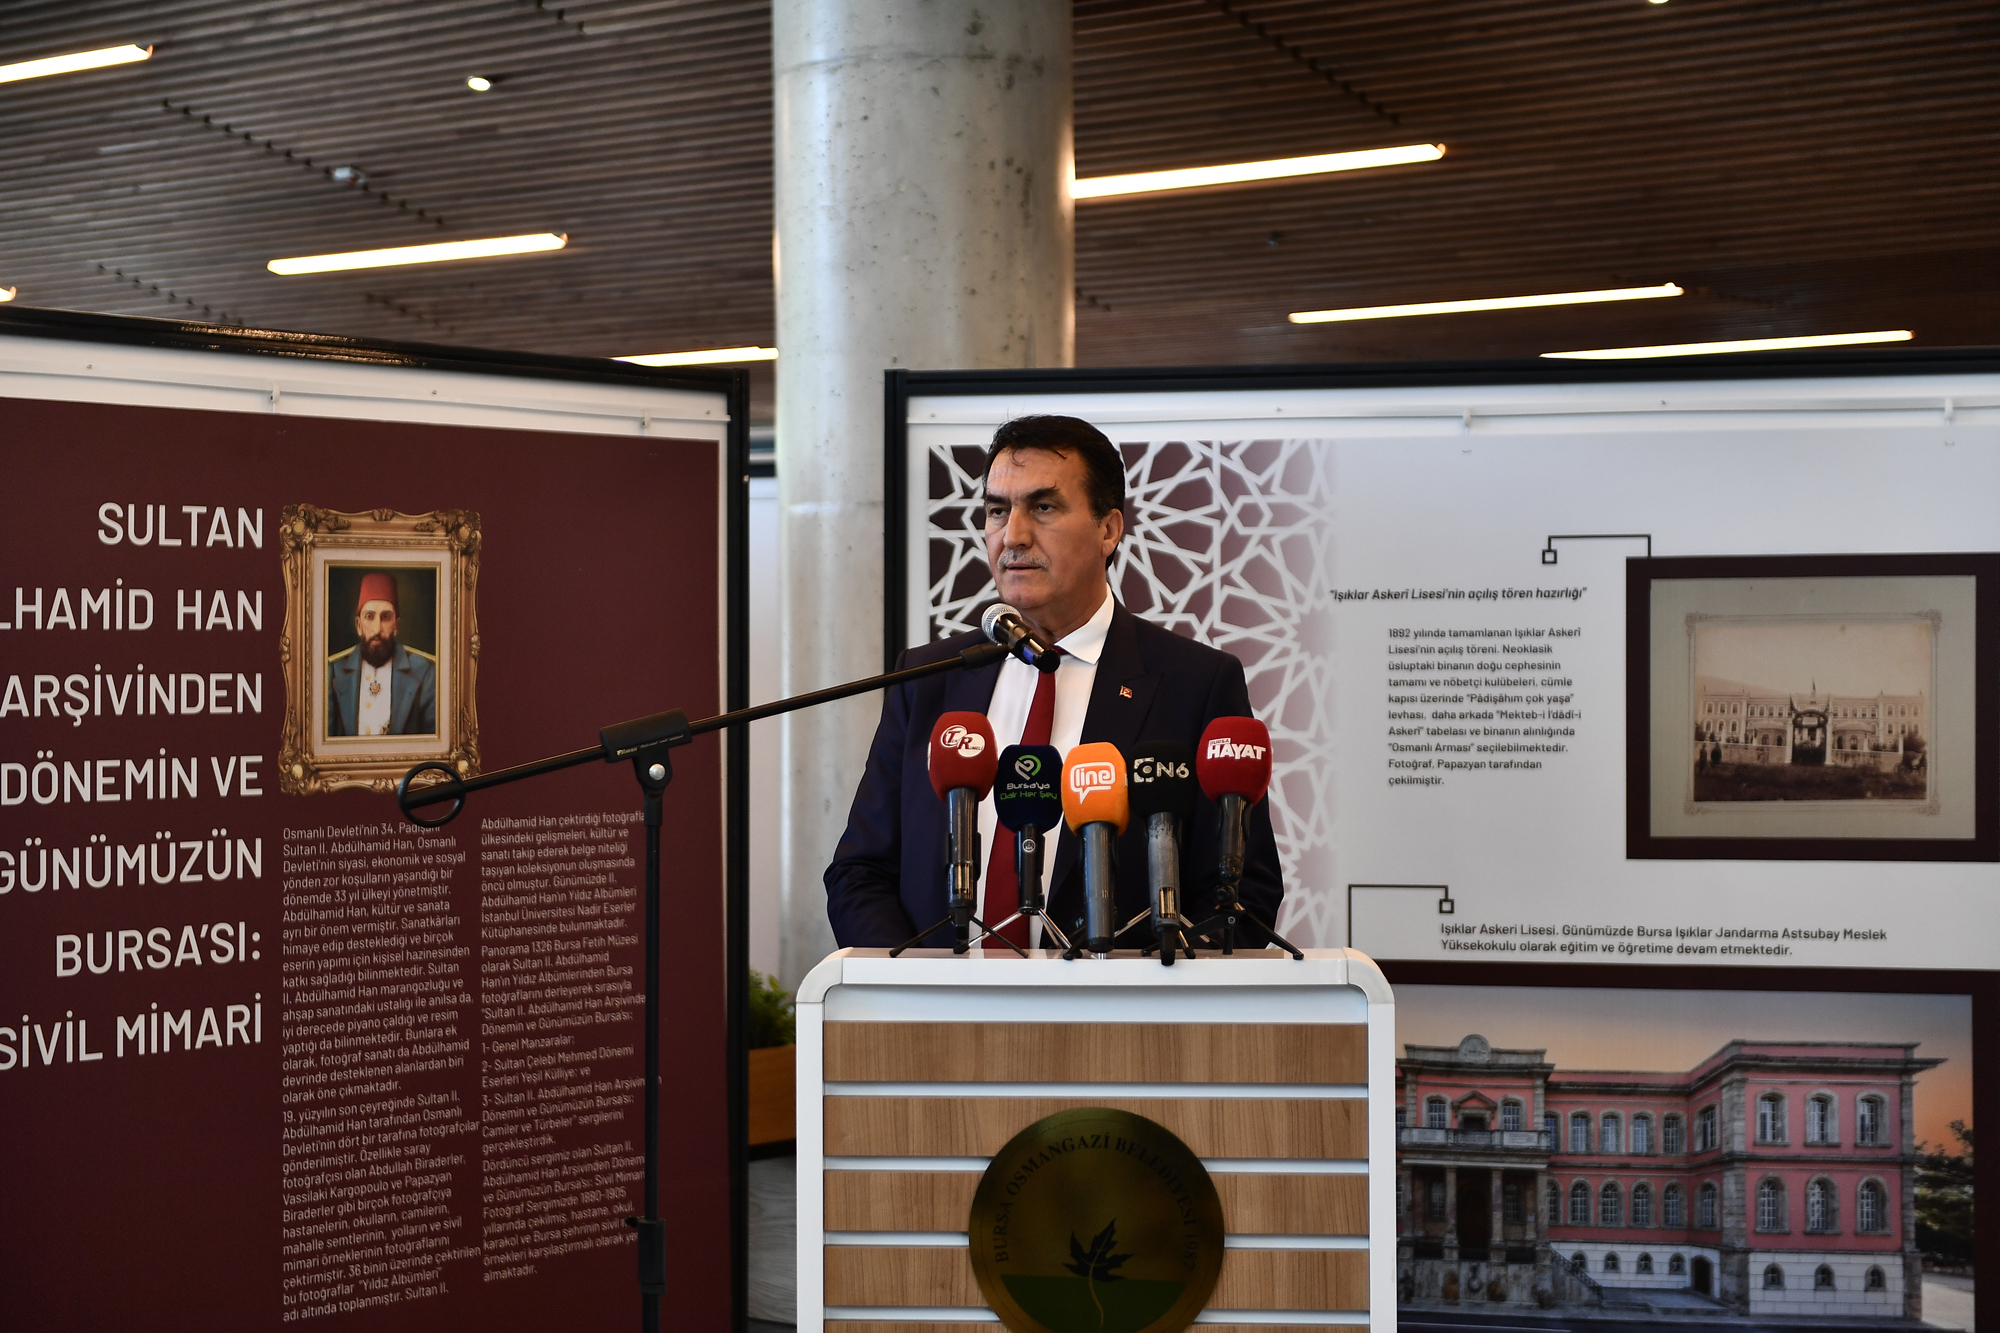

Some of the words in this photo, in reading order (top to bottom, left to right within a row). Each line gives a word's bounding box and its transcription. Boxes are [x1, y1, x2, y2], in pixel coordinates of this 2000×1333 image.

[98, 503, 262, 549] SULTAN
[1467, 588, 1498, 601] açılış
[1501, 587, 1533, 598] tören
[0, 577, 154, 631] HAMİD
[178, 589, 262, 631] HAN
[1388, 628, 1411, 638] 1892
[1412, 628, 1446, 639] yılında
[1447, 628, 1512, 638] tamamlanan
[1514, 627, 1545, 639] Işıklar
[1436, 644, 1464, 656] açılış
[1465, 645, 1499, 654] töreni.
[1501, 644, 1553, 654] Neoklasik
[1387, 661, 1435, 672] üsluptaki
[1436, 661, 1474, 670] binanın
[1476, 661, 1502, 672] doğu
[1504, 661, 1561, 671] cephesinin
[1387, 678, 1427, 687] tamamı
[1428, 679, 1441, 687] ve
[1442, 677, 1482, 688] nöbetçi
[1483, 677, 1538, 686] kulübeleri,
[1540, 677, 1572, 686] cümle
[0, 664, 262, 727] ARŞİVİNDEN
[1387, 694, 1418, 705] kapısı
[1419, 693, 1464, 703] üzerinde
[1524, 693, 1544, 705] çok
[1387, 710, 1426, 719] levhası,
[1430, 710, 1456, 719] daha
[1458, 710, 1494, 720] arkada
[1425, 726, 1467, 736] tabelası
[1468, 728, 1481, 736] ve
[1482, 726, 1520, 736] binanın
[1522, 726, 1575, 738] alınlığında
[1207, 743, 1266, 760] HAYAT
[1476, 742, 1568, 753] seçilebilmektedir.
[1387, 758, 1434, 770] Fotoğraf,
[1436, 758, 1486, 770] Papazyan
[1487, 759, 1542, 769] tarafından
[1, 748, 197, 806] DÖNEMİN
[211, 756, 262, 797] VE
[1007, 782, 1050, 790] Bursa'ya
[1075, 768, 1111, 787] line
[1387, 775, 1444, 786] çekilmiştir.
[283, 827, 324, 839] Osmanlı
[327, 824, 378, 837] Devleti'nin
[380, 822, 396, 834] 34.
[481, 832, 533, 844] ülkesindeki
[535, 829, 587, 844] gelişmeleri,
[590, 827, 616, 838] kültür
[618, 828, 628, 837] ve
[283, 844, 316, 856] Sultan
[319, 842, 327, 854] II.
[330, 839, 390, 852] Abdülhamid
[392, 838, 414, 849] Han,
[417, 836, 456, 848] Osmanlı
[481, 850, 510, 860] sanatı
[512, 847, 535, 860] takip
[537, 845, 569, 857] ederek
[570, 844, 596, 856] belge
[597, 842, 627, 854] niteliği
[0, 828, 262, 894] GÜNÜMÜZÜN
[283, 859, 335, 872] Devleti'nin
[338, 857, 368, 871] siyasi,
[371, 854, 420, 866] ekonomik
[421, 854, 433, 864] ve
[435, 851, 465, 864] sosyal
[481, 866, 515, 877] taşıyan
[517, 862, 576, 876] koleksiyonun
[578, 857, 635, 870] oluşmasında
[282, 876, 320, 891] yönden
[322, 876, 339, 886] zor
[341, 872, 390, 886] koşulların
[392, 869, 438, 884] yaşandığı
[440, 867, 453, 878] bir
[481, 879, 505, 891] öncü
[506, 878, 551, 890] olmuştur.
[553, 873, 606, 886] Günümüzde
[608, 872, 616, 882] II.
[282, 892, 331, 905] dönemde
[334, 889, 346, 901] 33
[348, 889, 359, 903] yıl
[361, 888, 390, 901] ülkeyi
[392, 884, 450, 900] yönetmiştir.
[282, 907, 343, 921] Abdülhamid
[346, 906, 368, 916] Han,
[371, 902, 400, 915] kültür
[403, 903, 414, 913] ve
[416, 900, 449, 911] sanata
[282, 928, 301, 940] ayrı
[304, 925, 317, 936] bir
[319, 924, 349, 935] önem
[351, 920, 398, 933] vermiştir.
[400, 915, 460, 928] Sanatkârları
[1440, 923, 1477, 936] Işıklar
[1478, 923, 1517, 935] Askeri
[1520, 924, 1559, 936] Lisesi.
[1561, 924, 1634, 936] Günümüzde
[1636, 925, 1672, 937] Bursa
[1675, 926, 1712, 939] Işıklar
[1714, 927, 1778, 938] Jandarma
[1780, 927, 1840, 941] Astsubay
[1842, 928, 1887, 940] Meslek
[57, 922, 261, 977] BURSA'SI:
[282, 943, 319, 955] himaye
[322, 939, 344, 952] edip
[346, 935, 407, 949] desteklediği
[409, 935, 421, 944] ve
[423, 930, 453, 944] birçok
[1440, 939, 1516, 951] Yüksekokulu
[1518, 940, 1557, 952] olarak
[1559, 941, 1598, 954] eğitim
[1600, 944, 1615, 953] ve
[1617, 941, 1673, 955] öğretime
[1676, 943, 1717, 954] devam
[1719, 944, 1792, 955] etmektedir.
[0, 1010, 104, 1070] SİVİL
[117, 993, 262, 1058] MİMARİ
[993, 1202, 1013, 1265] BURSA
[1006, 1131, 1110, 1196] OSMANGAZİ
[1182, 1234, 1199, 1271] 1987
[282, 1308, 298, 1321] adı
[300, 1302, 336, 1318] altında
[338, 1292, 402, 1311] toplanmıştır.
[405, 1286, 437, 1299] Sultan
[440, 1282, 448, 1293] II.
[283, 1293, 296, 1305] bu
[298, 1284, 354, 1301] fotoğraflar
